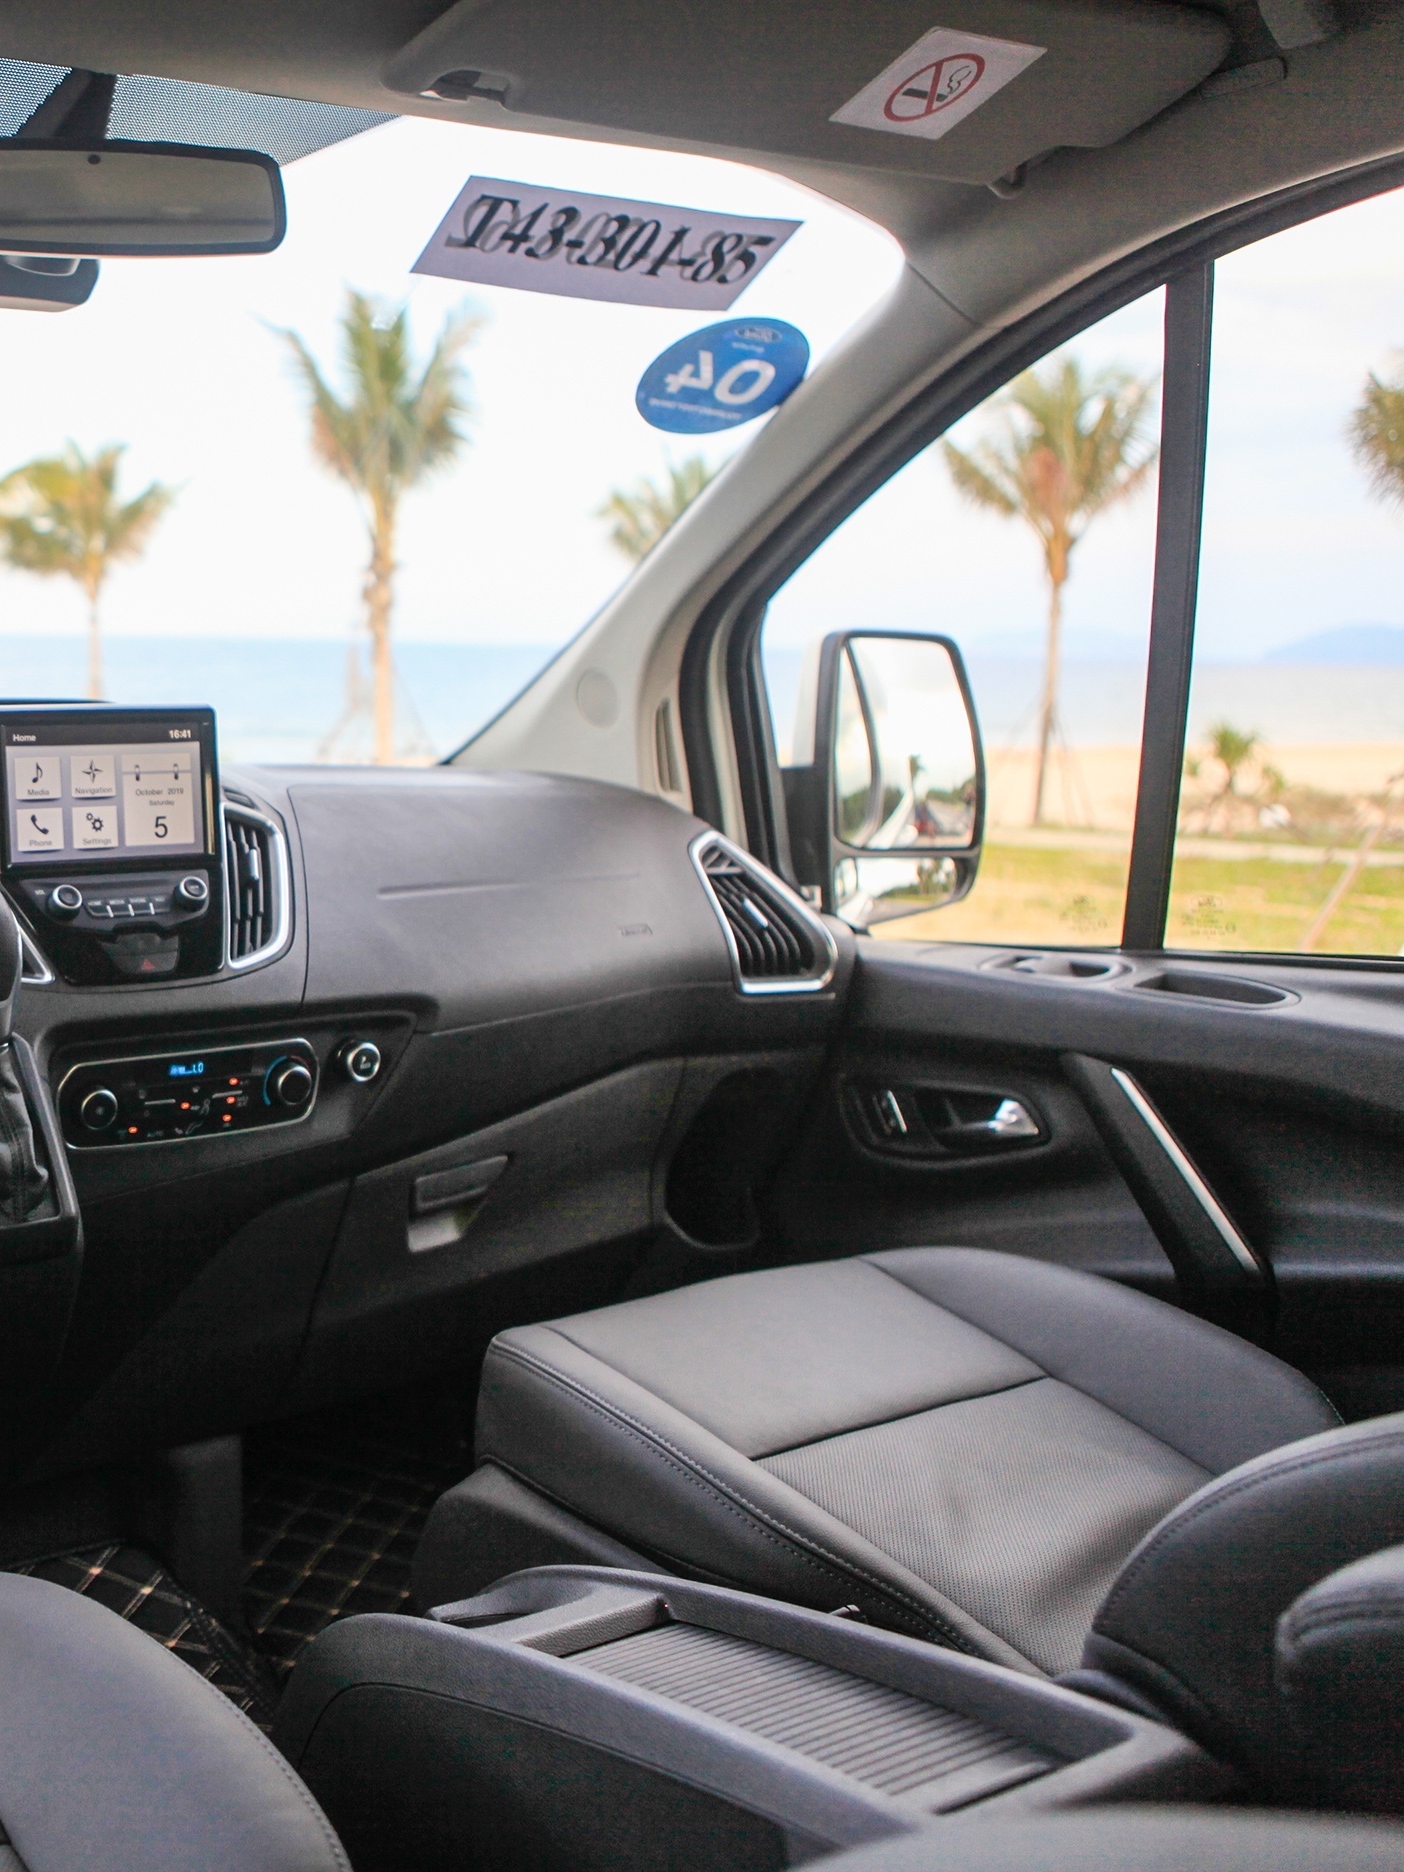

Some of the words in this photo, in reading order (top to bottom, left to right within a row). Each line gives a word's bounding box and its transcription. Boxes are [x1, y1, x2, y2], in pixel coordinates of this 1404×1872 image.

[12, 733, 37, 742] Home
[168, 729, 192, 739] 16:41
[27, 788, 50, 796] Media
[75, 786, 113, 795] Navigation
[135, 788, 164, 797] October
[154, 816, 168, 838] 5
[29, 839, 53, 847] Phone
[82, 837, 112, 846] Settings
